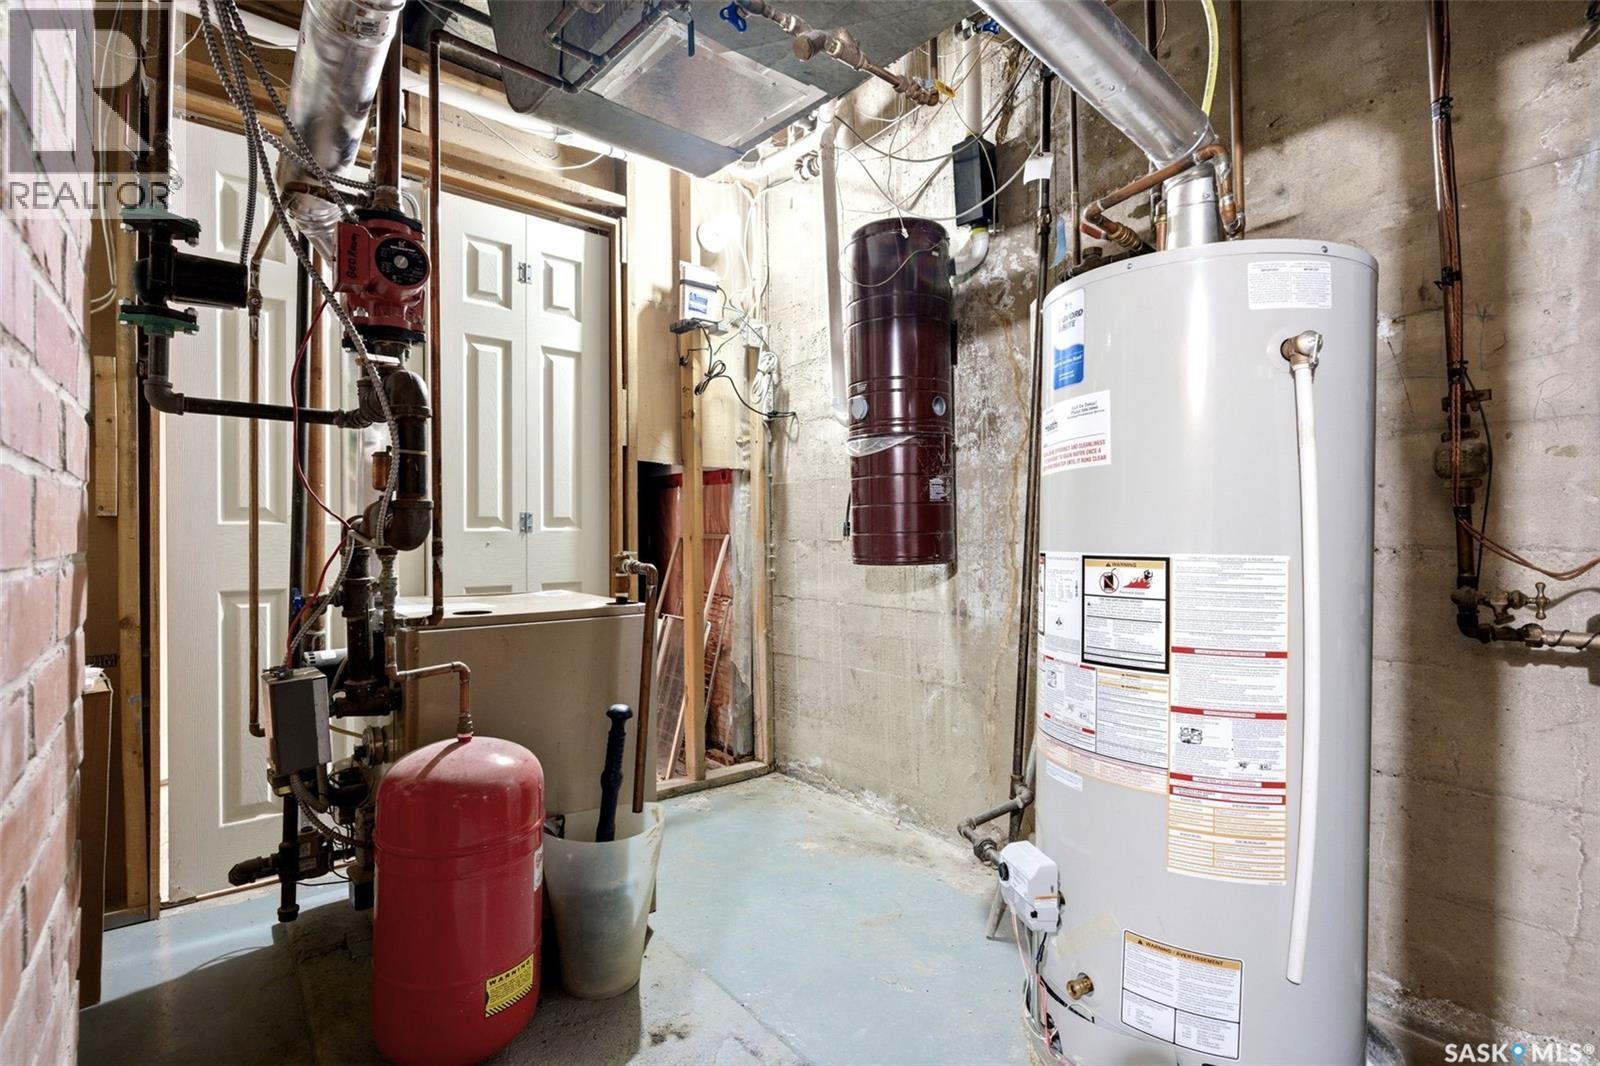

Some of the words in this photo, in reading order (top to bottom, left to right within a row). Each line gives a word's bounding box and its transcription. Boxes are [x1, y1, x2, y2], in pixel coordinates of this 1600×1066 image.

[1092, 454, 1107, 462] CLEAR
[1145, 941, 1172, 954] WARNING
[1175, 951, 1223, 966] AVERTISSEMENT
[489, 959, 530, 986] WARNING
